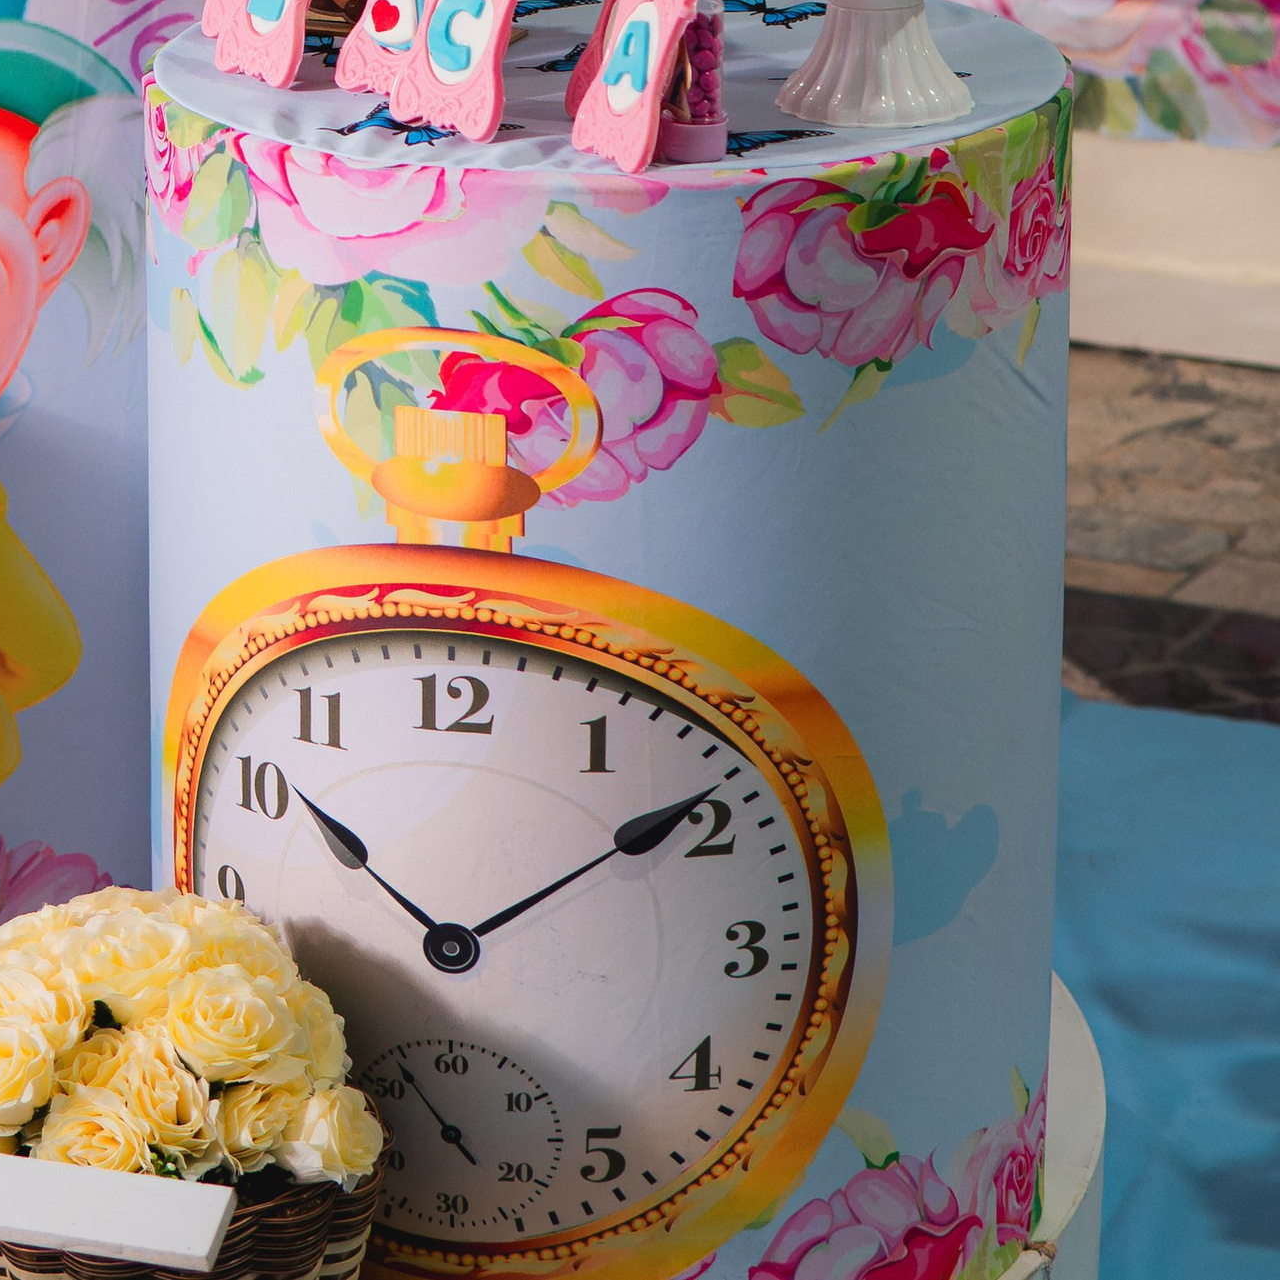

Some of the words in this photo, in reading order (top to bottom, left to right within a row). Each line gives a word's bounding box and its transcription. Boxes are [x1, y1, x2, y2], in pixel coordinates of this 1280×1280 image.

[292, 686, 347, 750] 11
[412, 675, 495, 736] 12
[579, 716, 616, 774] 1
[236, 755, 290, 820] 10
[683, 799, 737, 859] 2
[724, 920, 769, 978] 3
[374, 1076, 405, 1100] 50
[434, 1053, 469, 1075] 60
[669, 1035, 722, 1092] 4
[504, 1092, 533, 1112] 10
[388, 1150, 405, 1171] 0
[497, 1162, 534, 1183] 20
[581, 1125, 626, 1183] 5
[436, 1193, 469, 1215] 30
